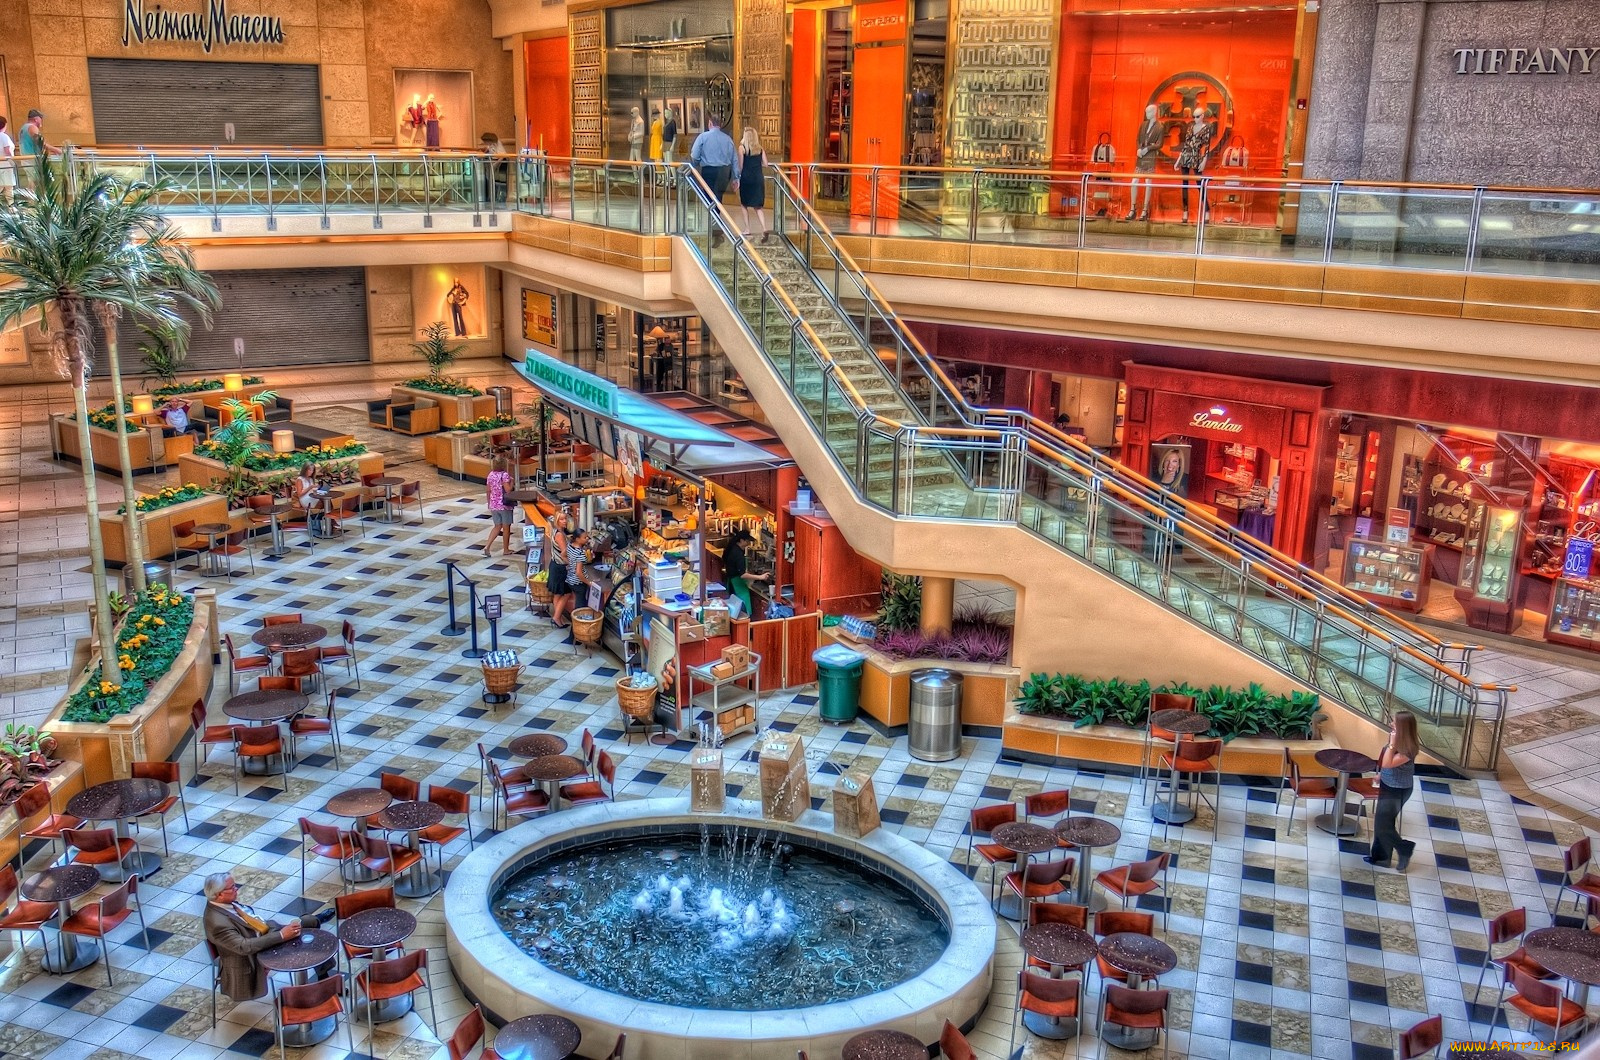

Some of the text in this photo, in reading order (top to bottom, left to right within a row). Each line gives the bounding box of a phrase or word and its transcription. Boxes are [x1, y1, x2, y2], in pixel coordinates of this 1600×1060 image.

[121, 0, 287, 53] Neiman Marcus
[1453, 47, 1600, 75] TIFFANY
[526, 356, 610, 410] STARBUCKS COFFEE
[1189, 413, 1243, 433] Landau
[1565, 552, 1581, 572] 80
